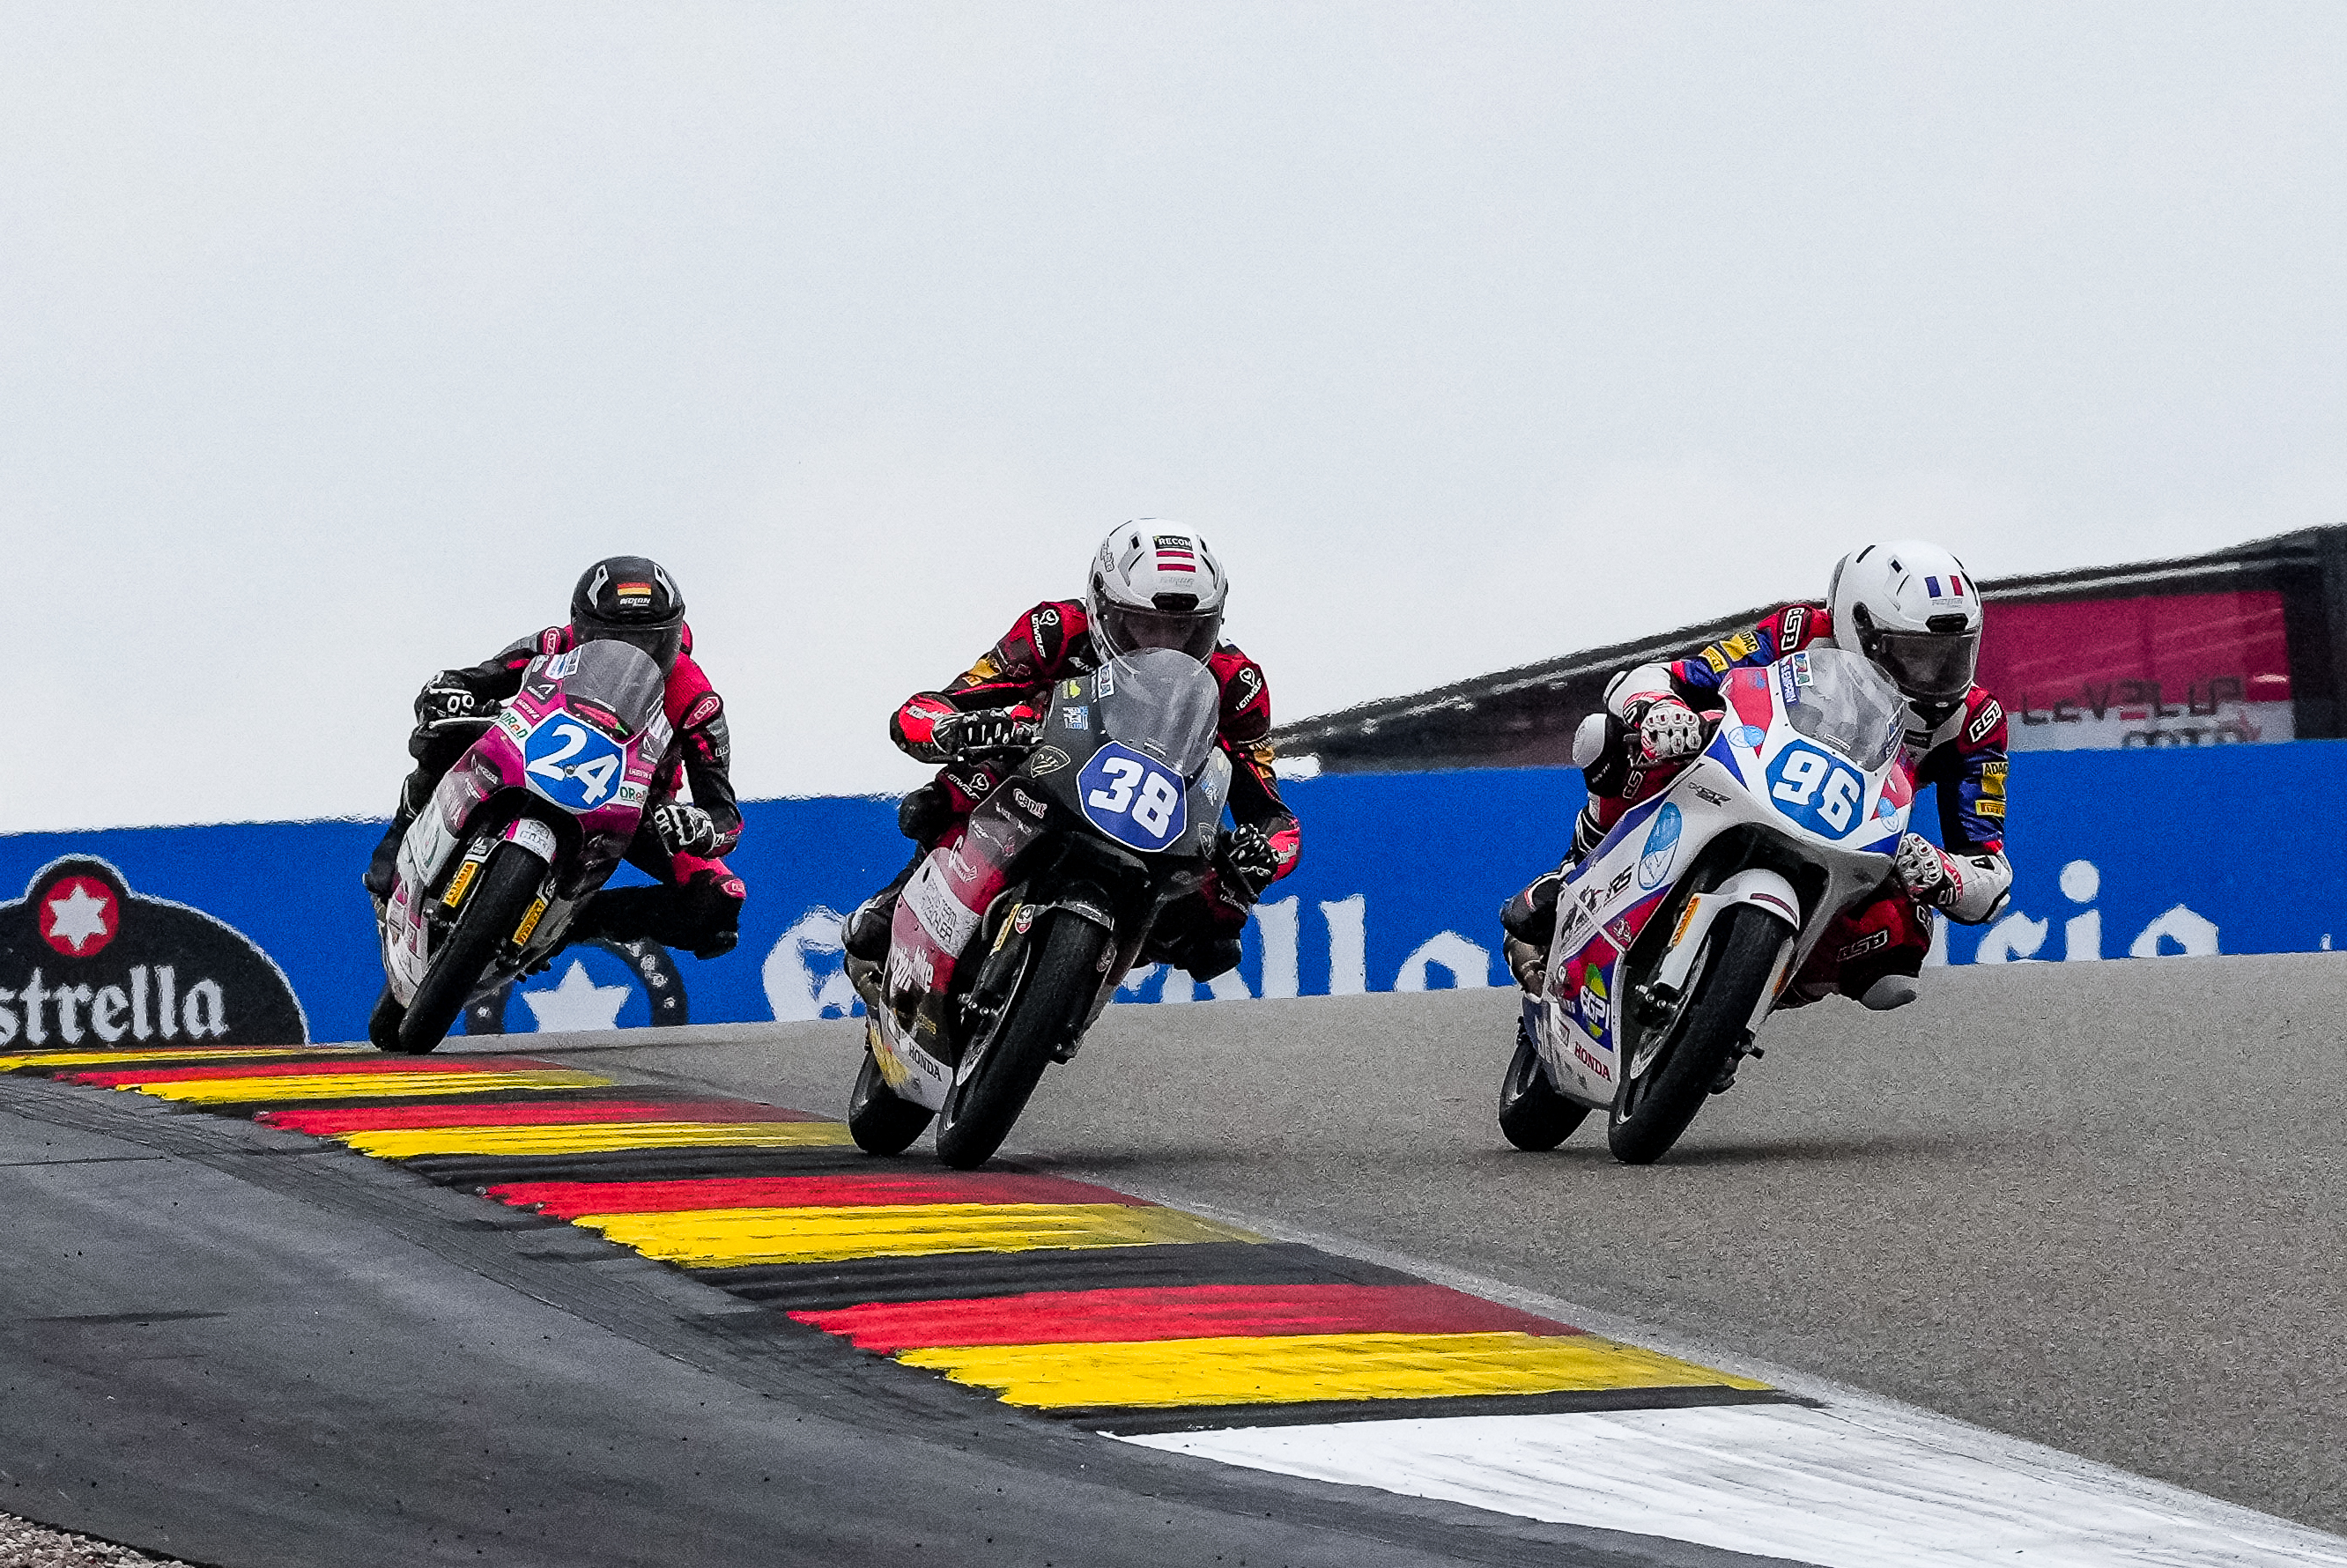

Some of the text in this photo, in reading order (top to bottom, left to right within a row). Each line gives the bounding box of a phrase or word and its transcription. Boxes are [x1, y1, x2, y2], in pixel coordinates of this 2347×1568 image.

[1158, 536, 1192, 547] RECON
[527, 724, 620, 805] 24
[1772, 750, 1861, 832] 96
[1088, 756, 1177, 839] 38
[908, 1041, 943, 1083] HONDA
[1573, 1040, 1612, 1084] HONDA
